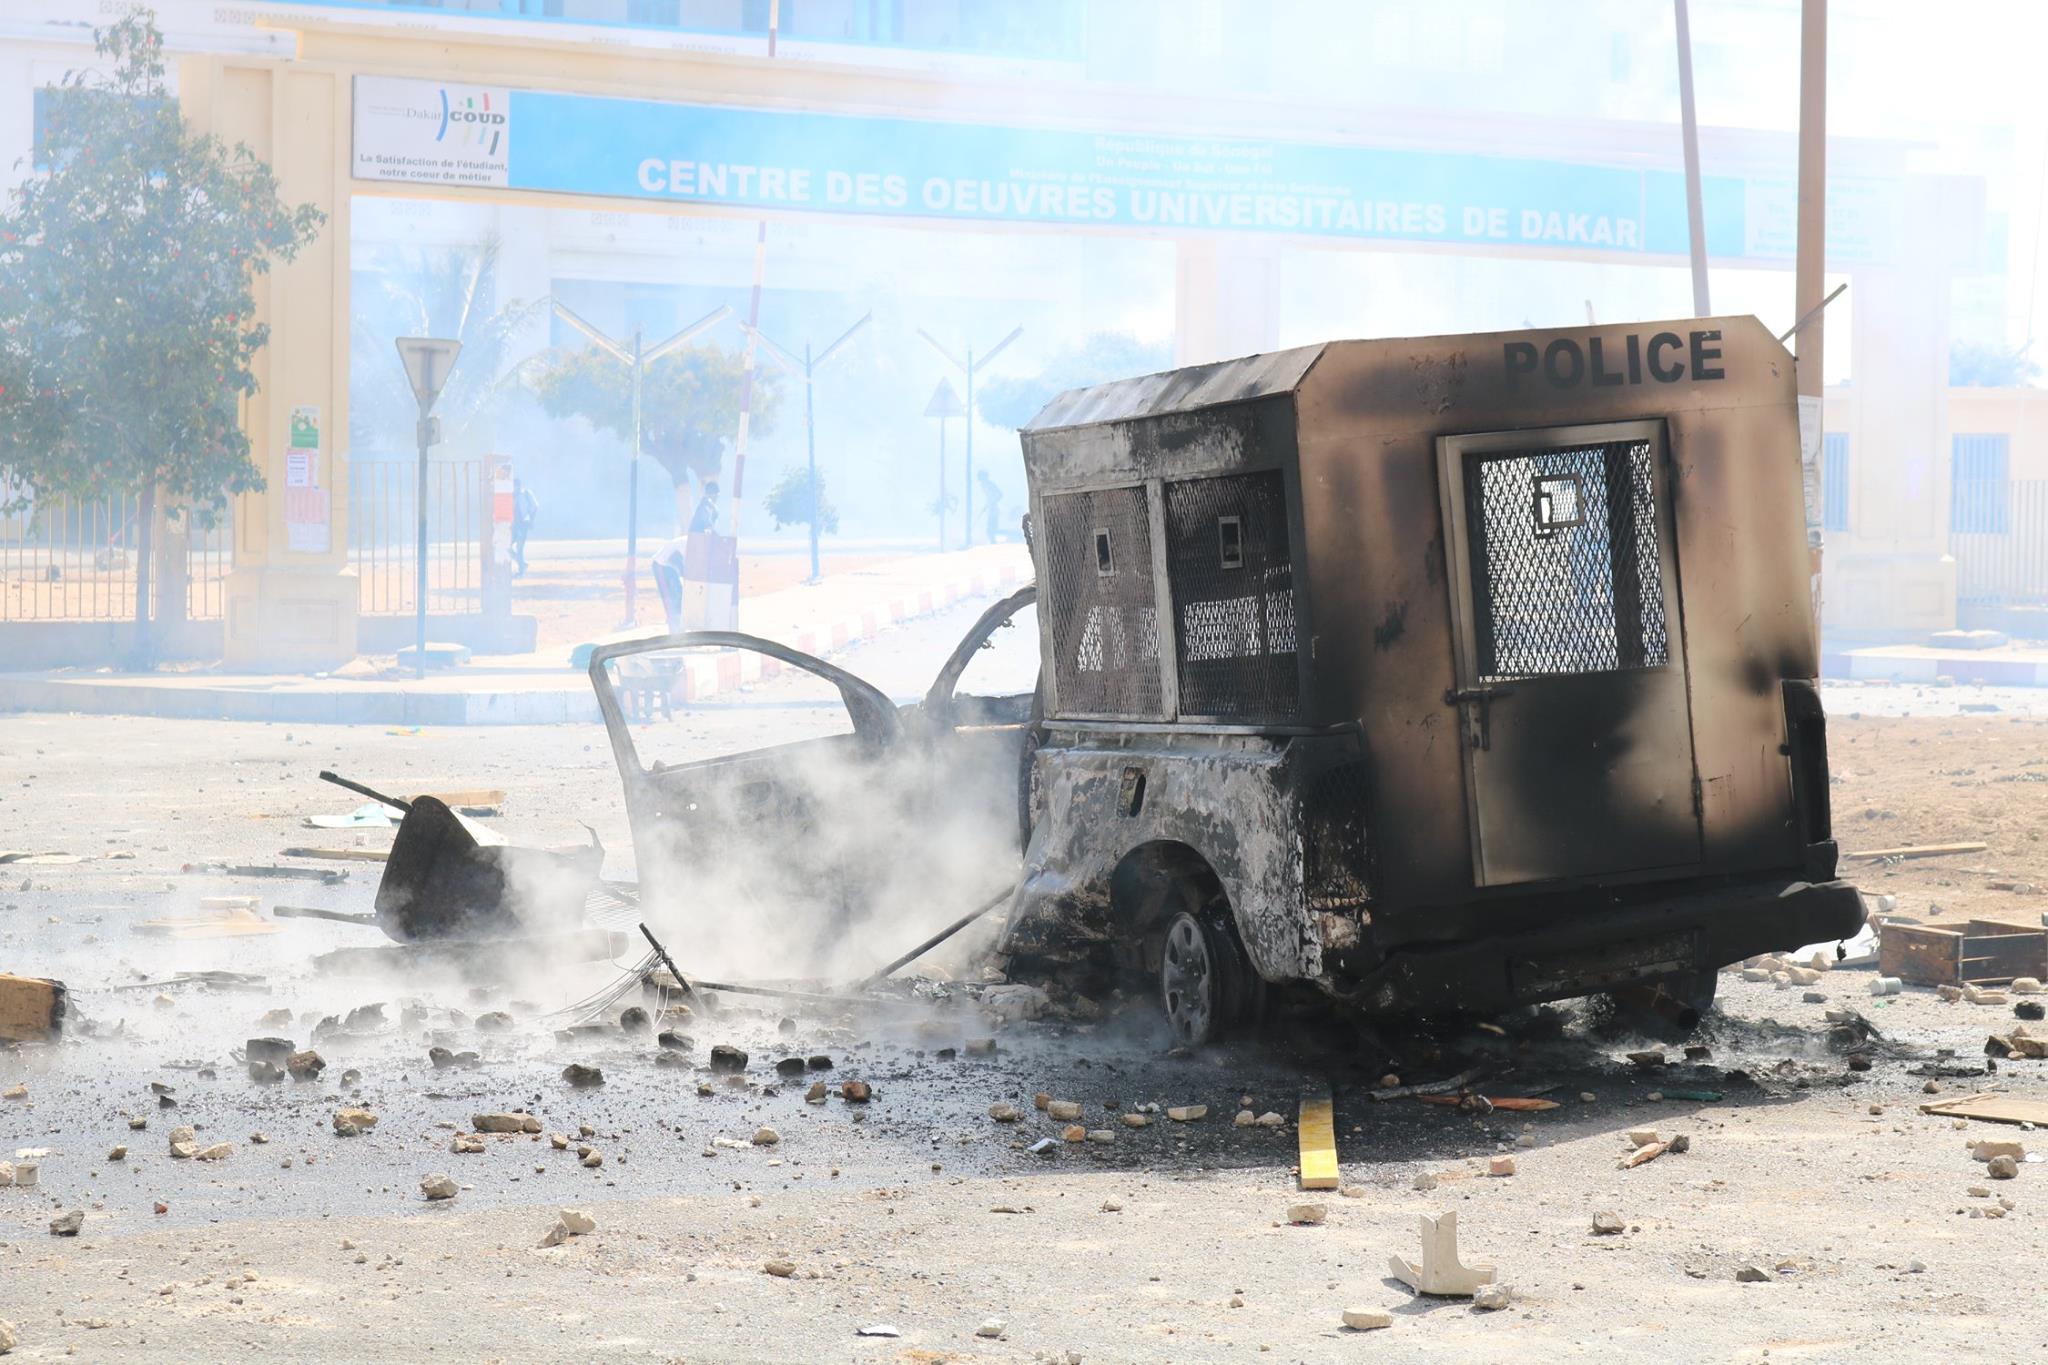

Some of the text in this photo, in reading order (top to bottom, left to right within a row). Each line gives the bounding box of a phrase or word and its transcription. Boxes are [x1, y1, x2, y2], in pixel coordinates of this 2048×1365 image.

[406, 108, 442, 120] Dakar
[450, 111, 506, 124] COUD
[360, 154, 372, 163] La
[376, 155, 438, 167] Satisfaction
[441, 158, 454, 168] de
[379, 168, 492, 182] notre coeur de métier
[638, 158, 1639, 247] CENTRE DES OEUVRES UNIVERSITAIRES DE DAKAR
[1503, 330, 1725, 393] POLICE
